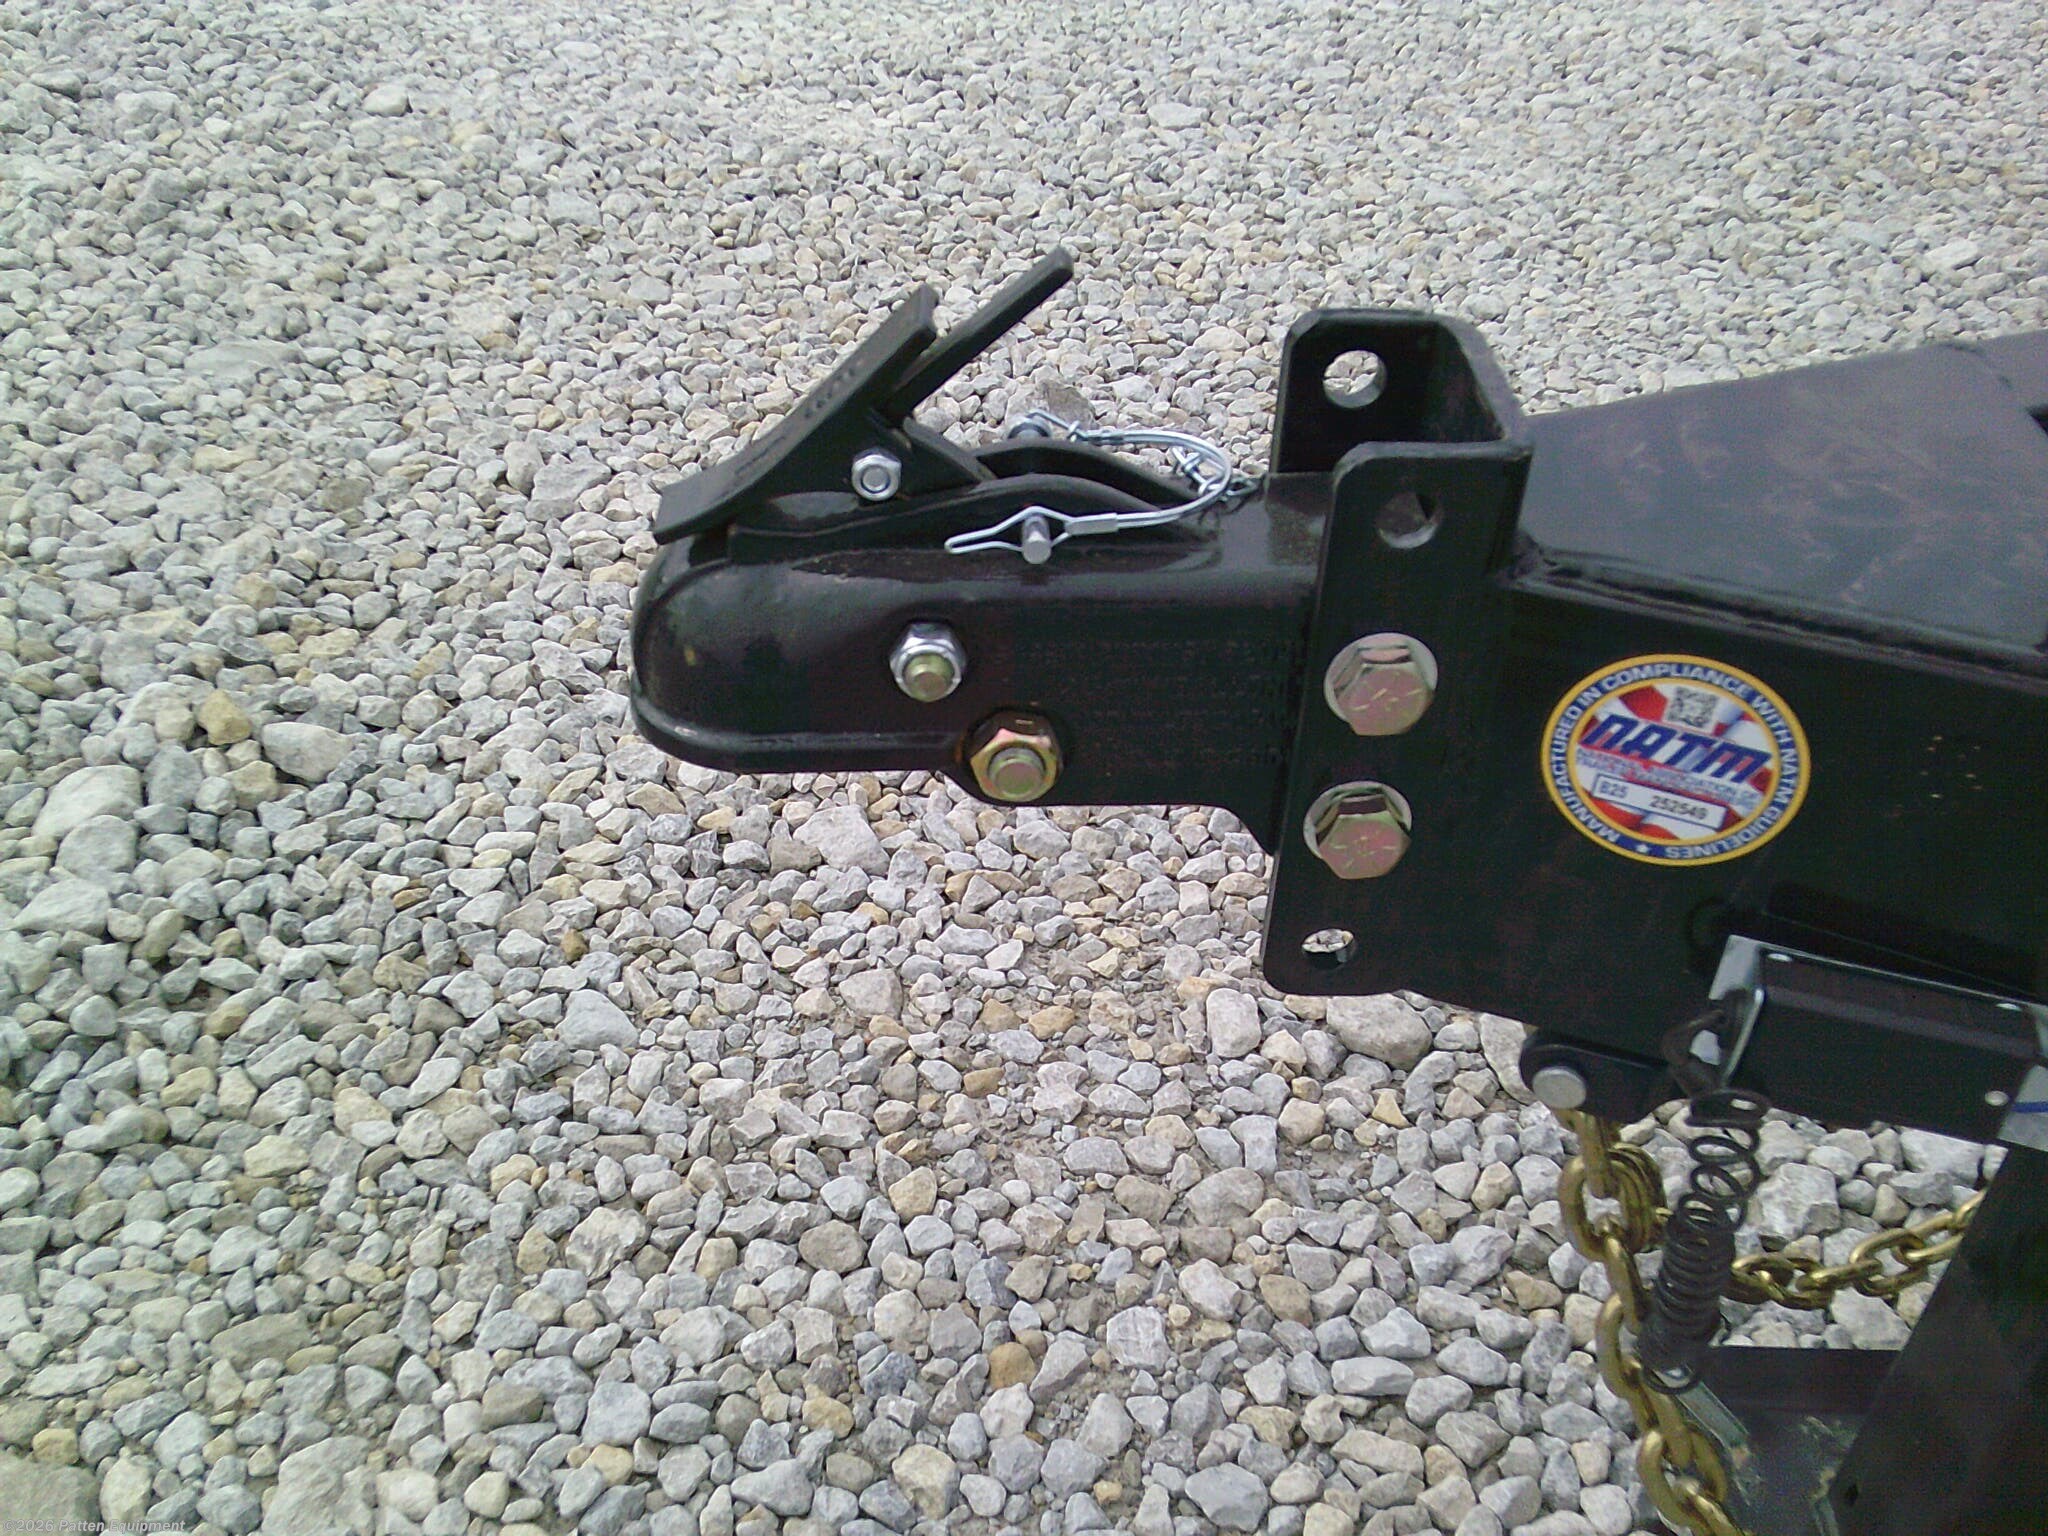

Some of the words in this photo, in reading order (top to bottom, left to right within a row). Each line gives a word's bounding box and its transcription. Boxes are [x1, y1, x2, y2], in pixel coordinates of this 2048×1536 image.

[1578, 686, 1602, 708] IN
[1603, 663, 1754, 699] COMPLIANCE
[1750, 693, 1792, 745] WITH
[1551, 702, 1621, 843] MANUFACTURED
[1779, 747, 1798, 803] NATM
[1664, 803, 1783, 859] GUIDELINES
